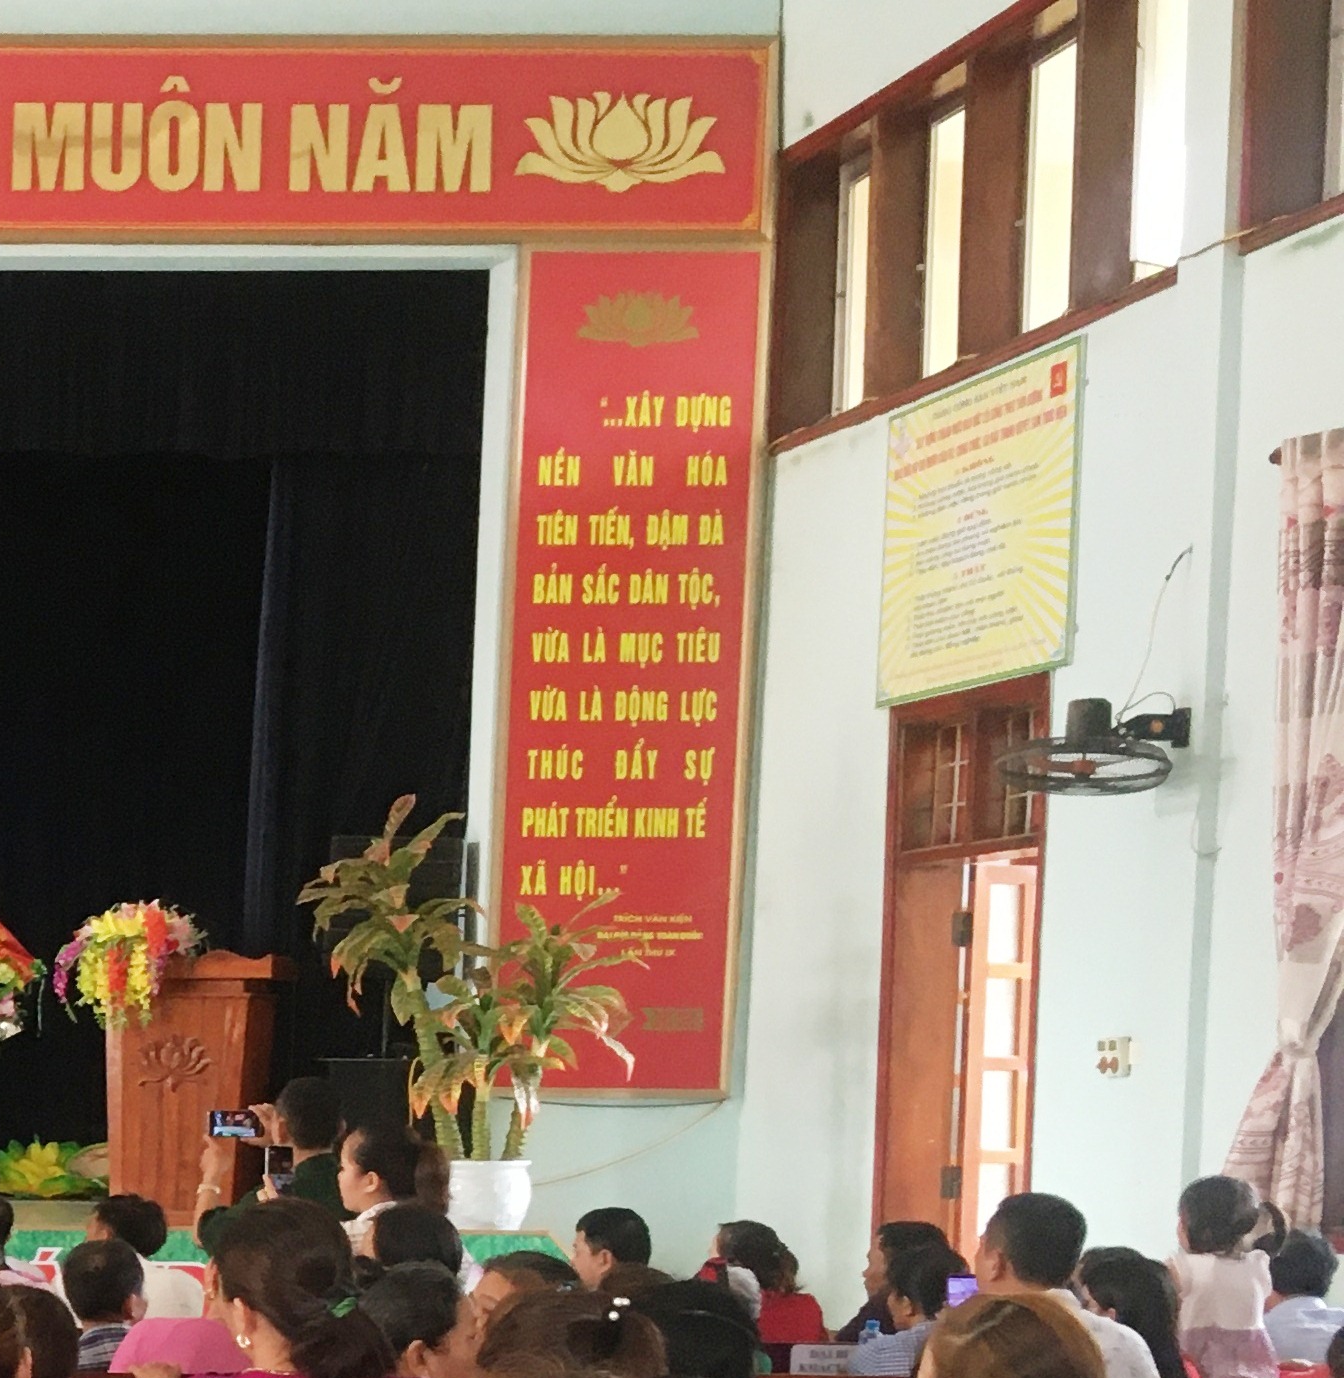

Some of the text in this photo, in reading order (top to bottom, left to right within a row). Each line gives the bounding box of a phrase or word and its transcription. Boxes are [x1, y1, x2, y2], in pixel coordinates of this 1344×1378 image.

[12, 75, 264, 193] MUÔN
[289, 78, 493, 194] NĂM
[676, 393, 731, 433] DỰNG
[538, 447, 727, 487] NỀN VĂN HÓA
[537, 509, 578, 545] TIÊN
[589, 506, 634, 550] TIẾN,
[533, 563, 720, 610] BẢN SẮC DÂN TỘC,
[532, 627, 720, 668] VỪA LÀ MỤC TIÊU
[530, 685, 717, 727] VỪA LÀ ĐỘNG LỰC
[528, 738, 715, 785] THÚC ĐẨY SỰ
[522, 795, 706, 838] PHÁT TRIỂN KINH TẾ
[520, 859, 547, 895] XÃ
